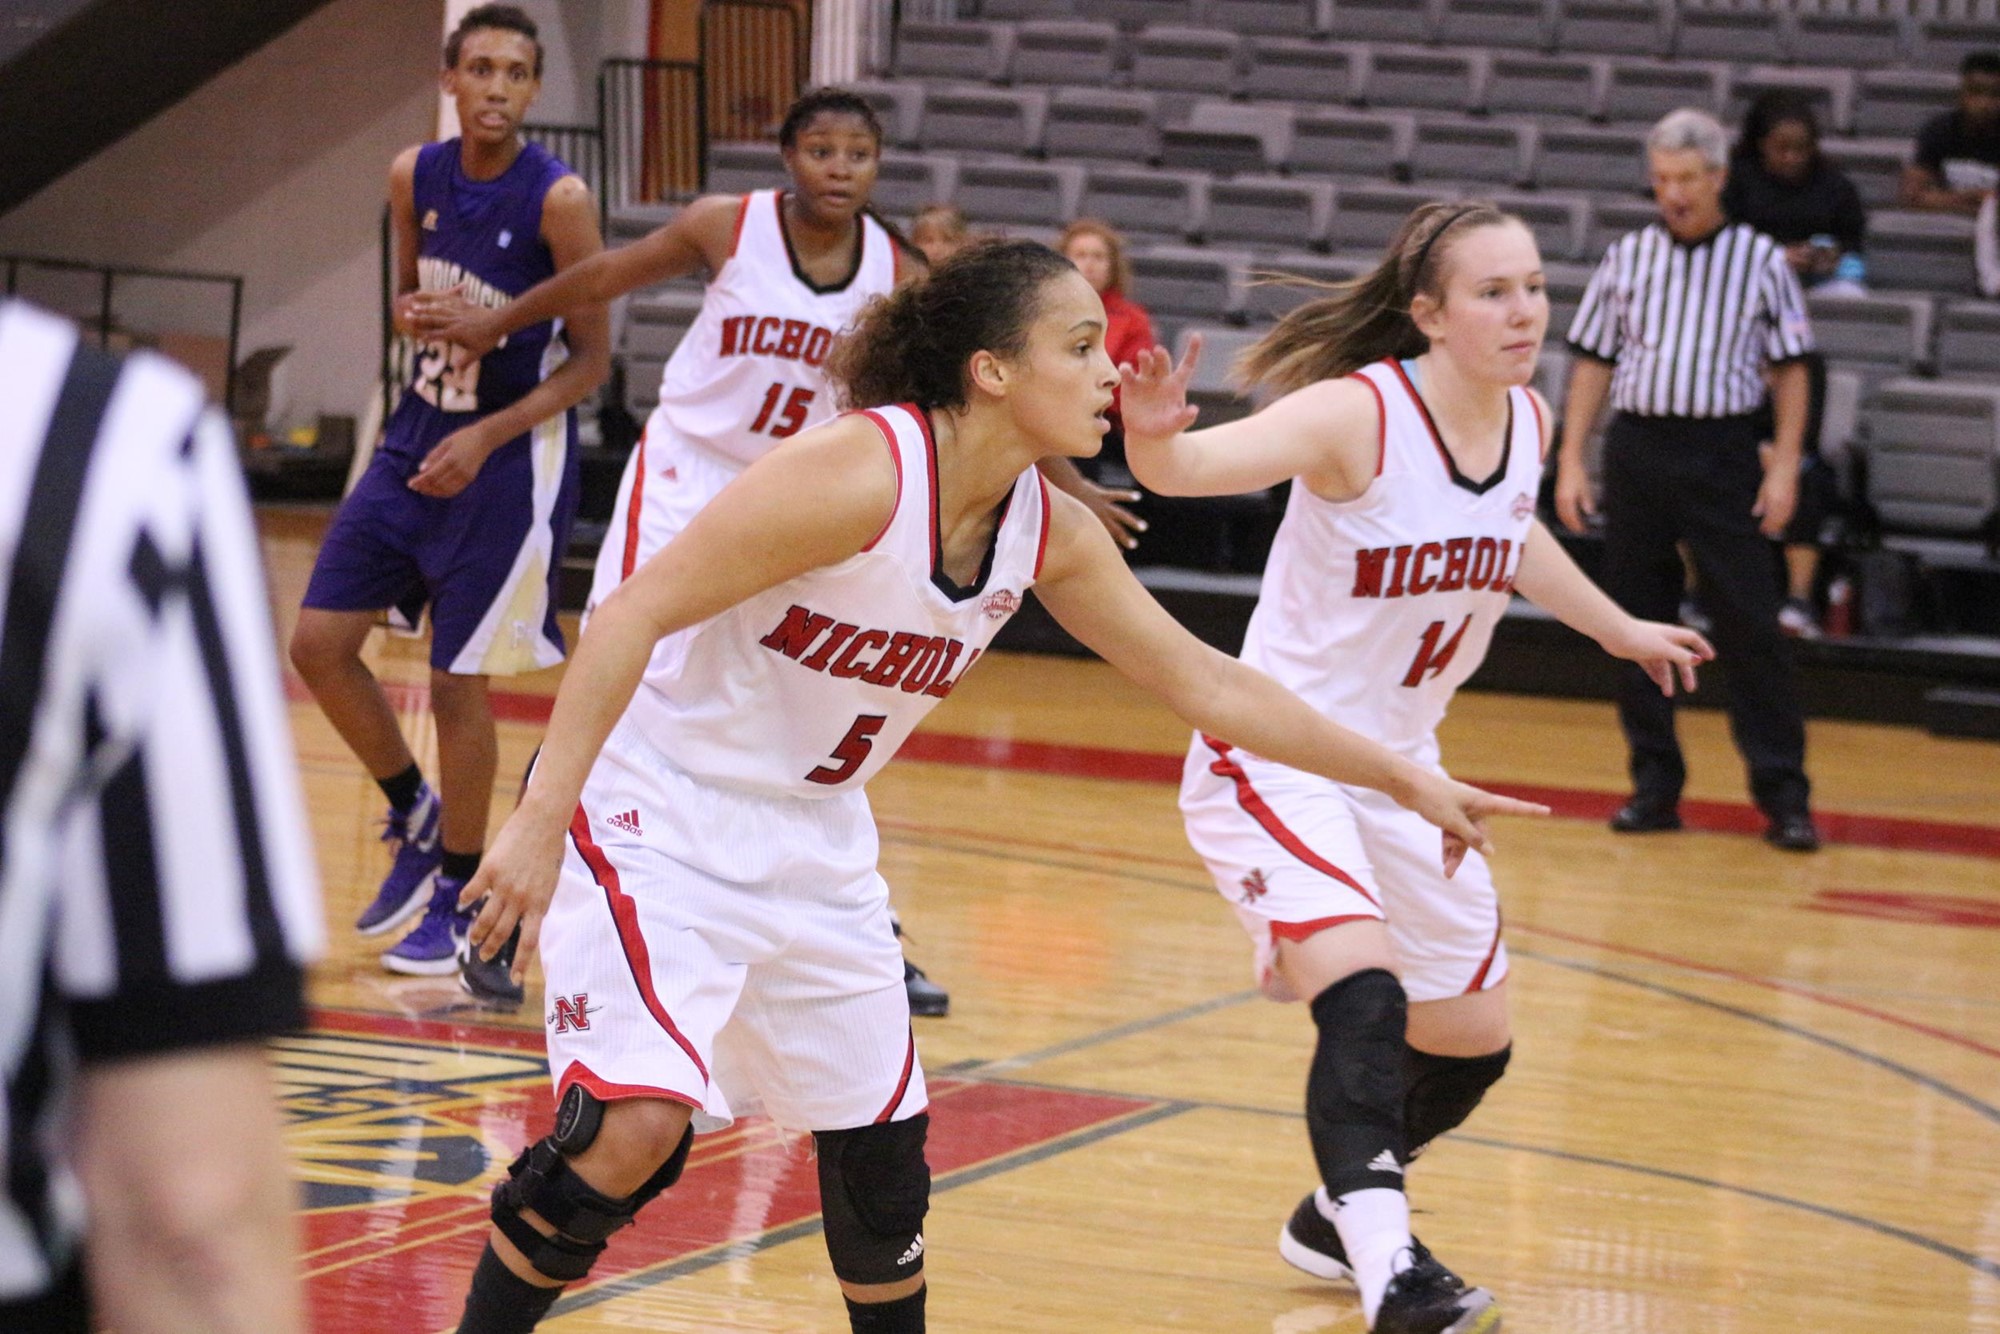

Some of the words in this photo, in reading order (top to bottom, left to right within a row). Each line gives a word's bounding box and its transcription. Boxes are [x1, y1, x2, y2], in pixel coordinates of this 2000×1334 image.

[719, 316, 833, 368] NICHO
[750, 383, 816, 439] 15
[1352, 536, 1524, 598] NICHOL
[1401, 613, 1474, 688] 14
[804, 714, 888, 785] 5
[606, 816, 643, 837] adidas
[555, 993, 590, 1034] N
